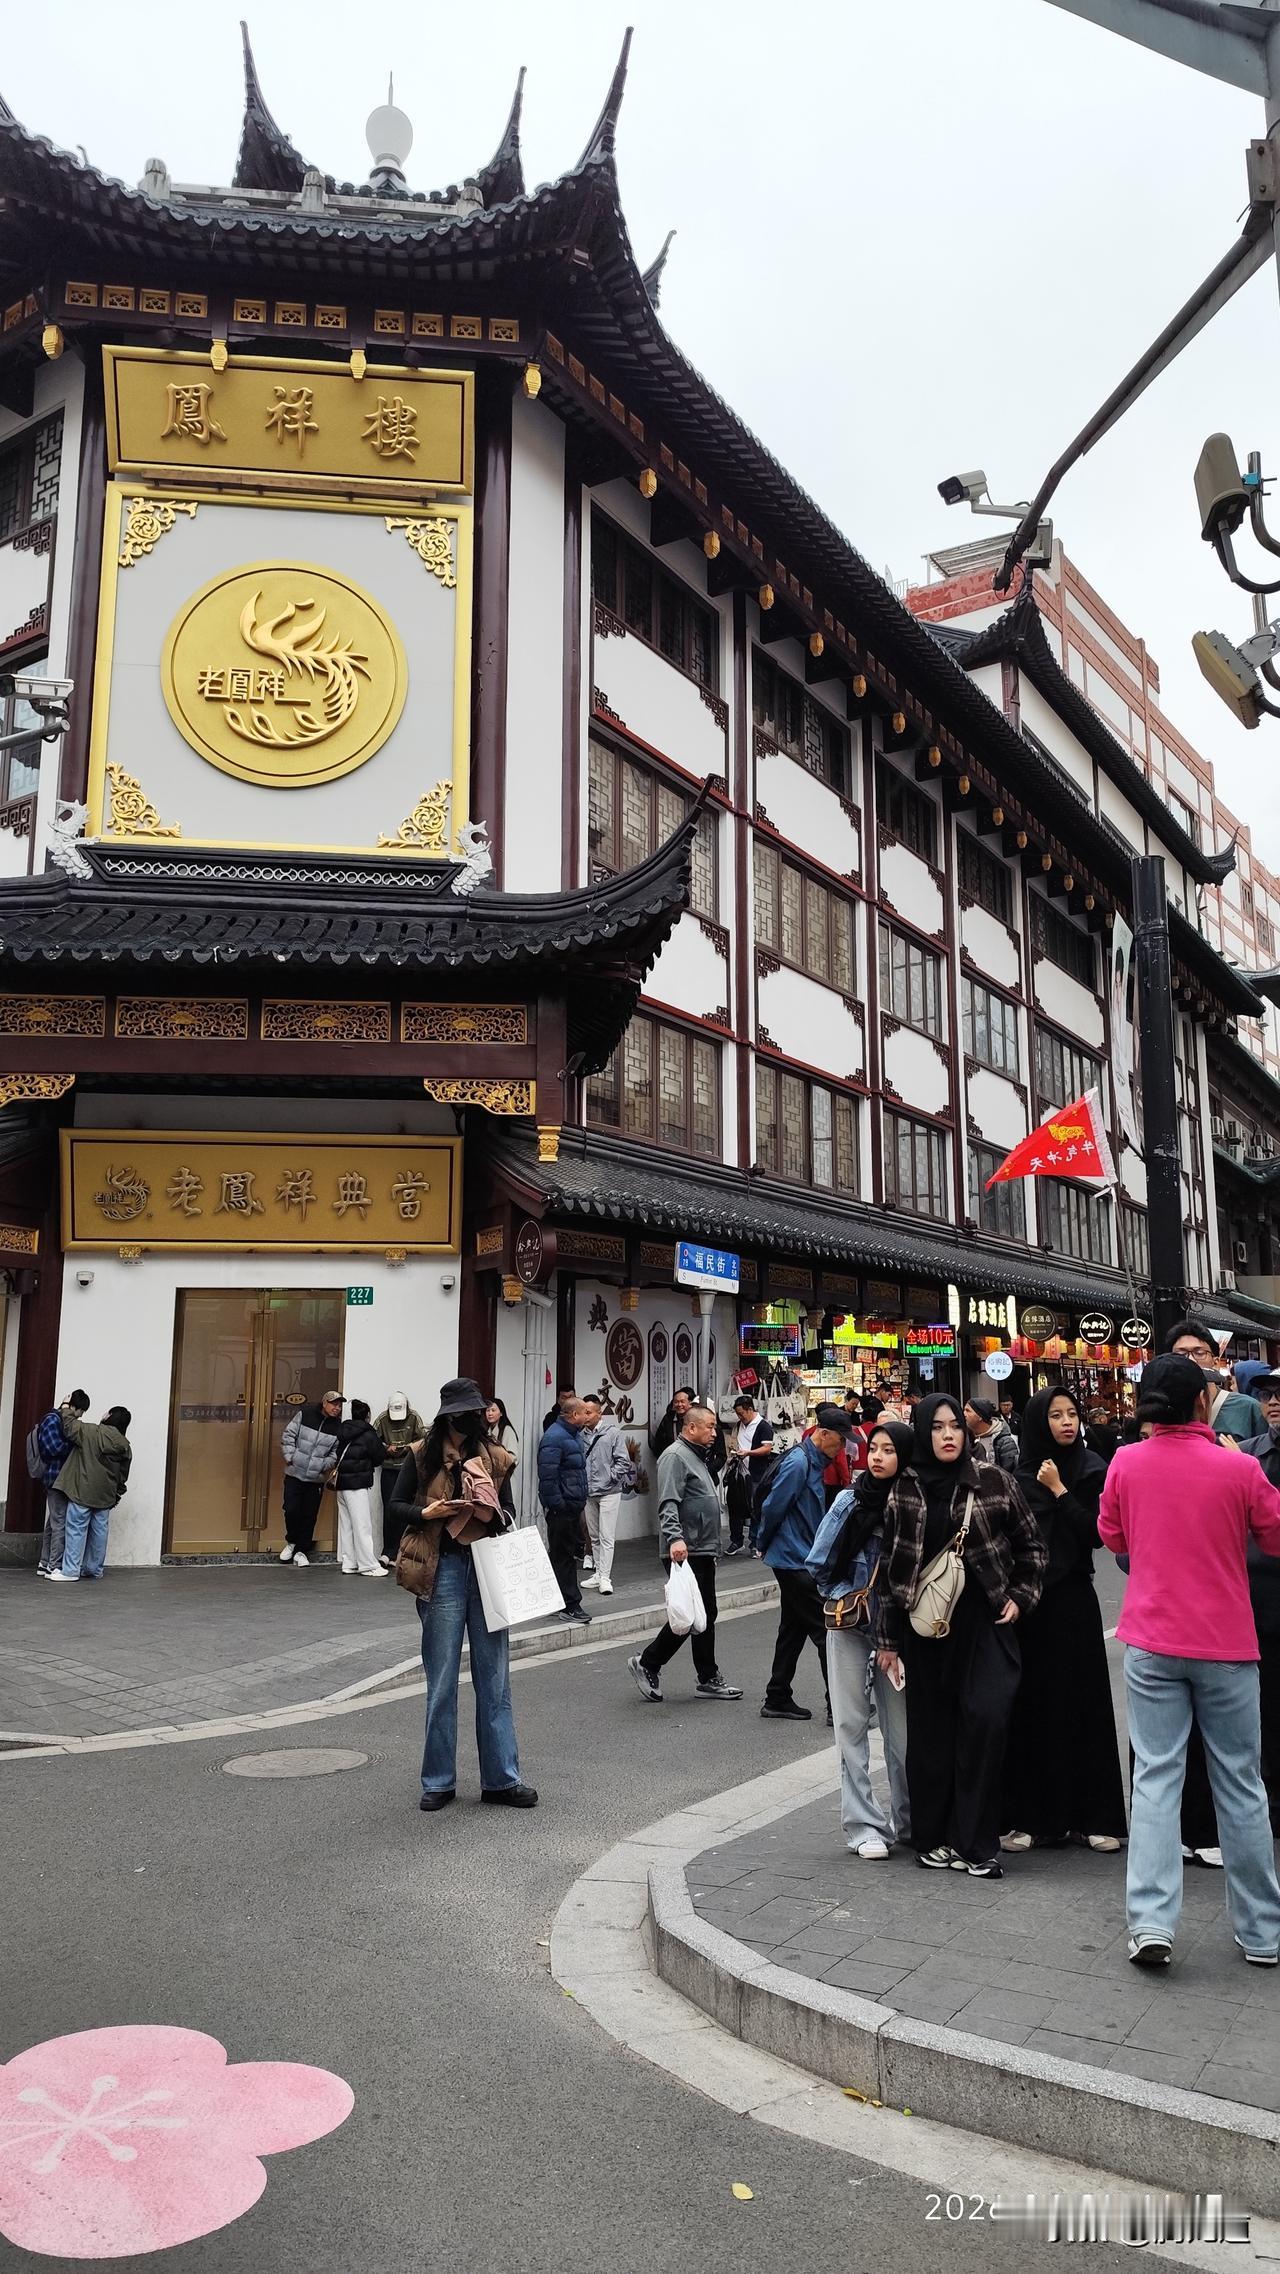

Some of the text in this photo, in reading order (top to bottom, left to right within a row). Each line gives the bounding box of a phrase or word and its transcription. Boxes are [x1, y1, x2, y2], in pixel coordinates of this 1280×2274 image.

[160, 382, 421, 463] 鳳祥樓
[197, 665, 311, 705] 老鳳祥
[166, 1166, 431, 1223] 老鳳祥典當
[695, 1250, 726, 1275] 福民街
[350, 1288, 370, 1298] 227
[906, 1328, 954, 1345] 全场10元
